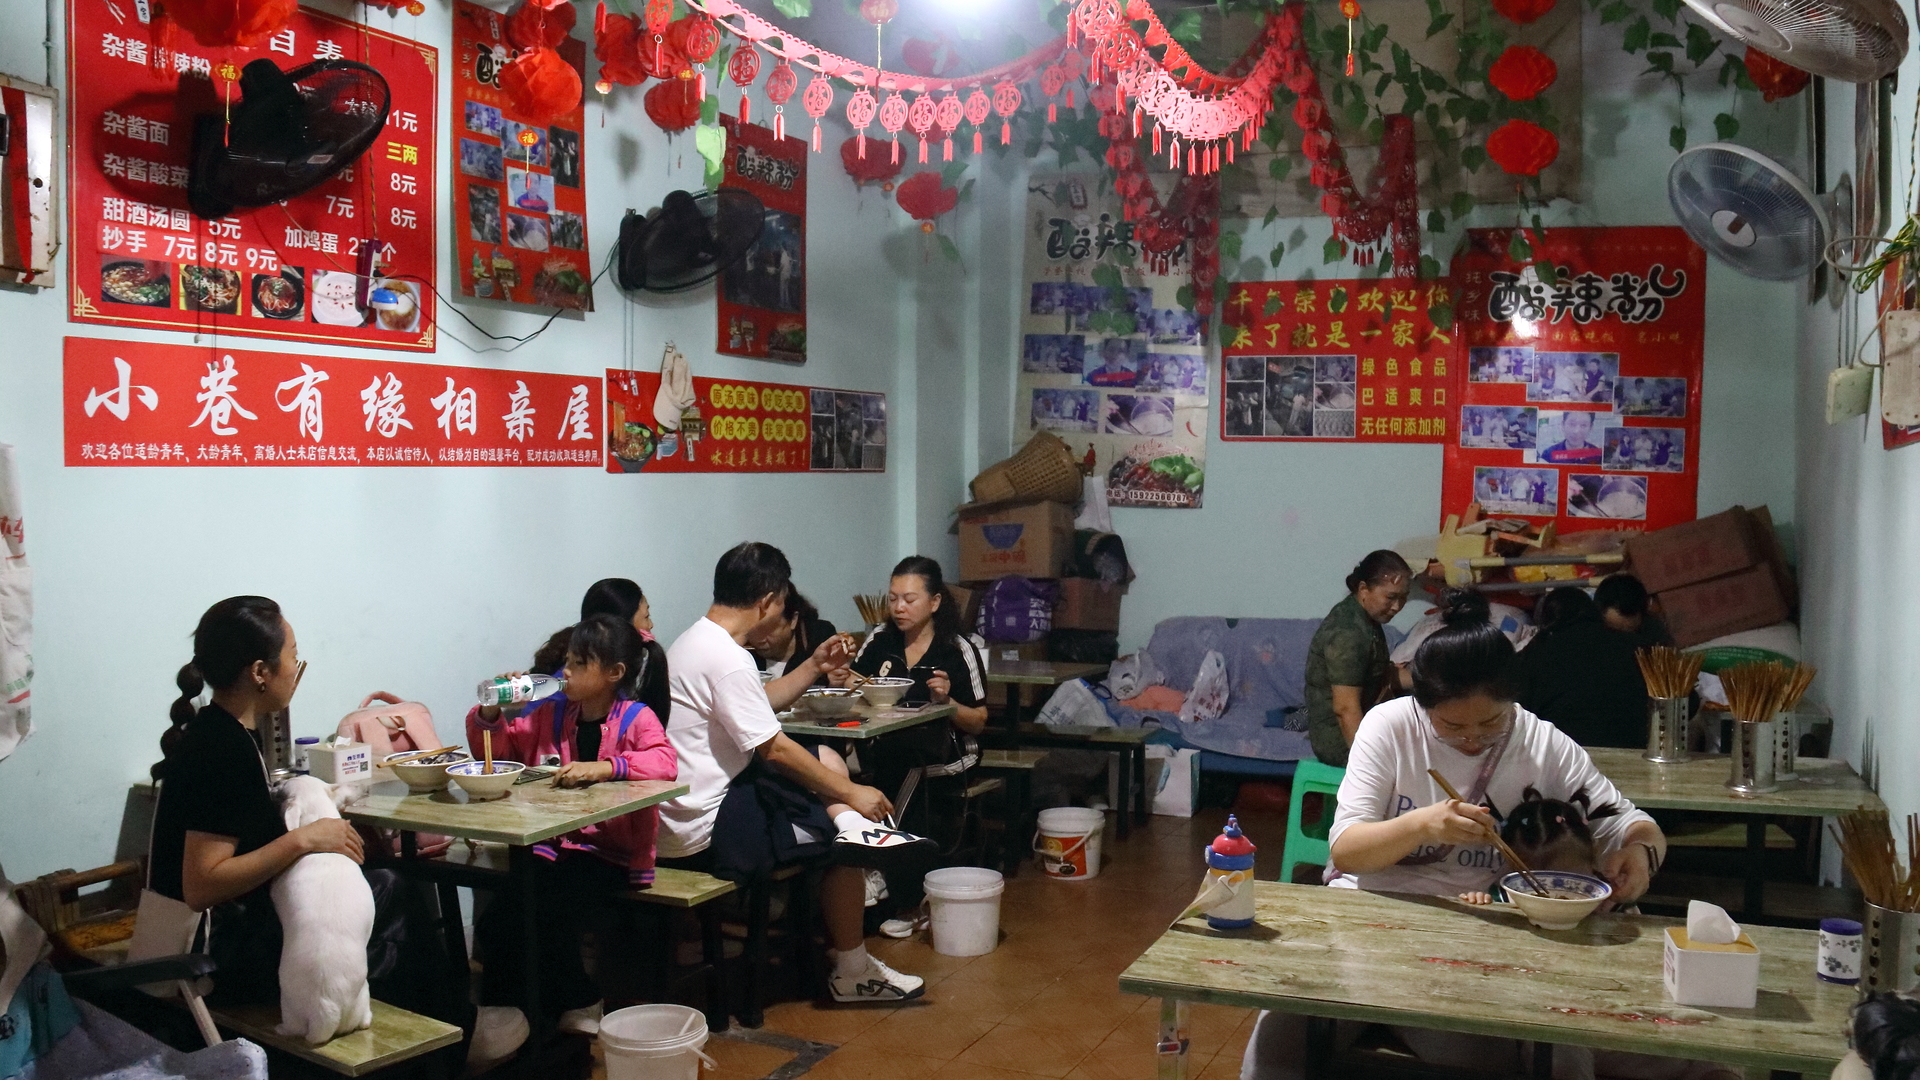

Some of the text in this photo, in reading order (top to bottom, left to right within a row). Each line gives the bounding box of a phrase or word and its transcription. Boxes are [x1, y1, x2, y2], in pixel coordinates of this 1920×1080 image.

[221, 65, 236, 80] 福
[103, 111, 170, 146] 杂酱面
[391, 173, 416, 195] 8元
[387, 141, 418, 165] 三两
[103, 153, 416, 229] 杂酱酸菜 7元 8元
[103, 197, 190, 232] 甜酒汤圆
[285, 226, 338, 254] 加鸡蛋
[103, 226, 278, 271] 抄手 7元 8元 9元
[1488, 263, 1687, 324] 酸辣粉
[1231, 319, 1450, 349] 来了就是一家人
[1362, 358, 1447, 376] 绿色食品
[84, 354, 594, 443] 小巷有缘相亲屋
[713, 388, 756, 406] 原汤原味
[1362, 388, 1447, 406] 巴适爽口
[713, 420, 757, 437] 价格不贵
[1361, 417, 1446, 436] 无任何添加剂
